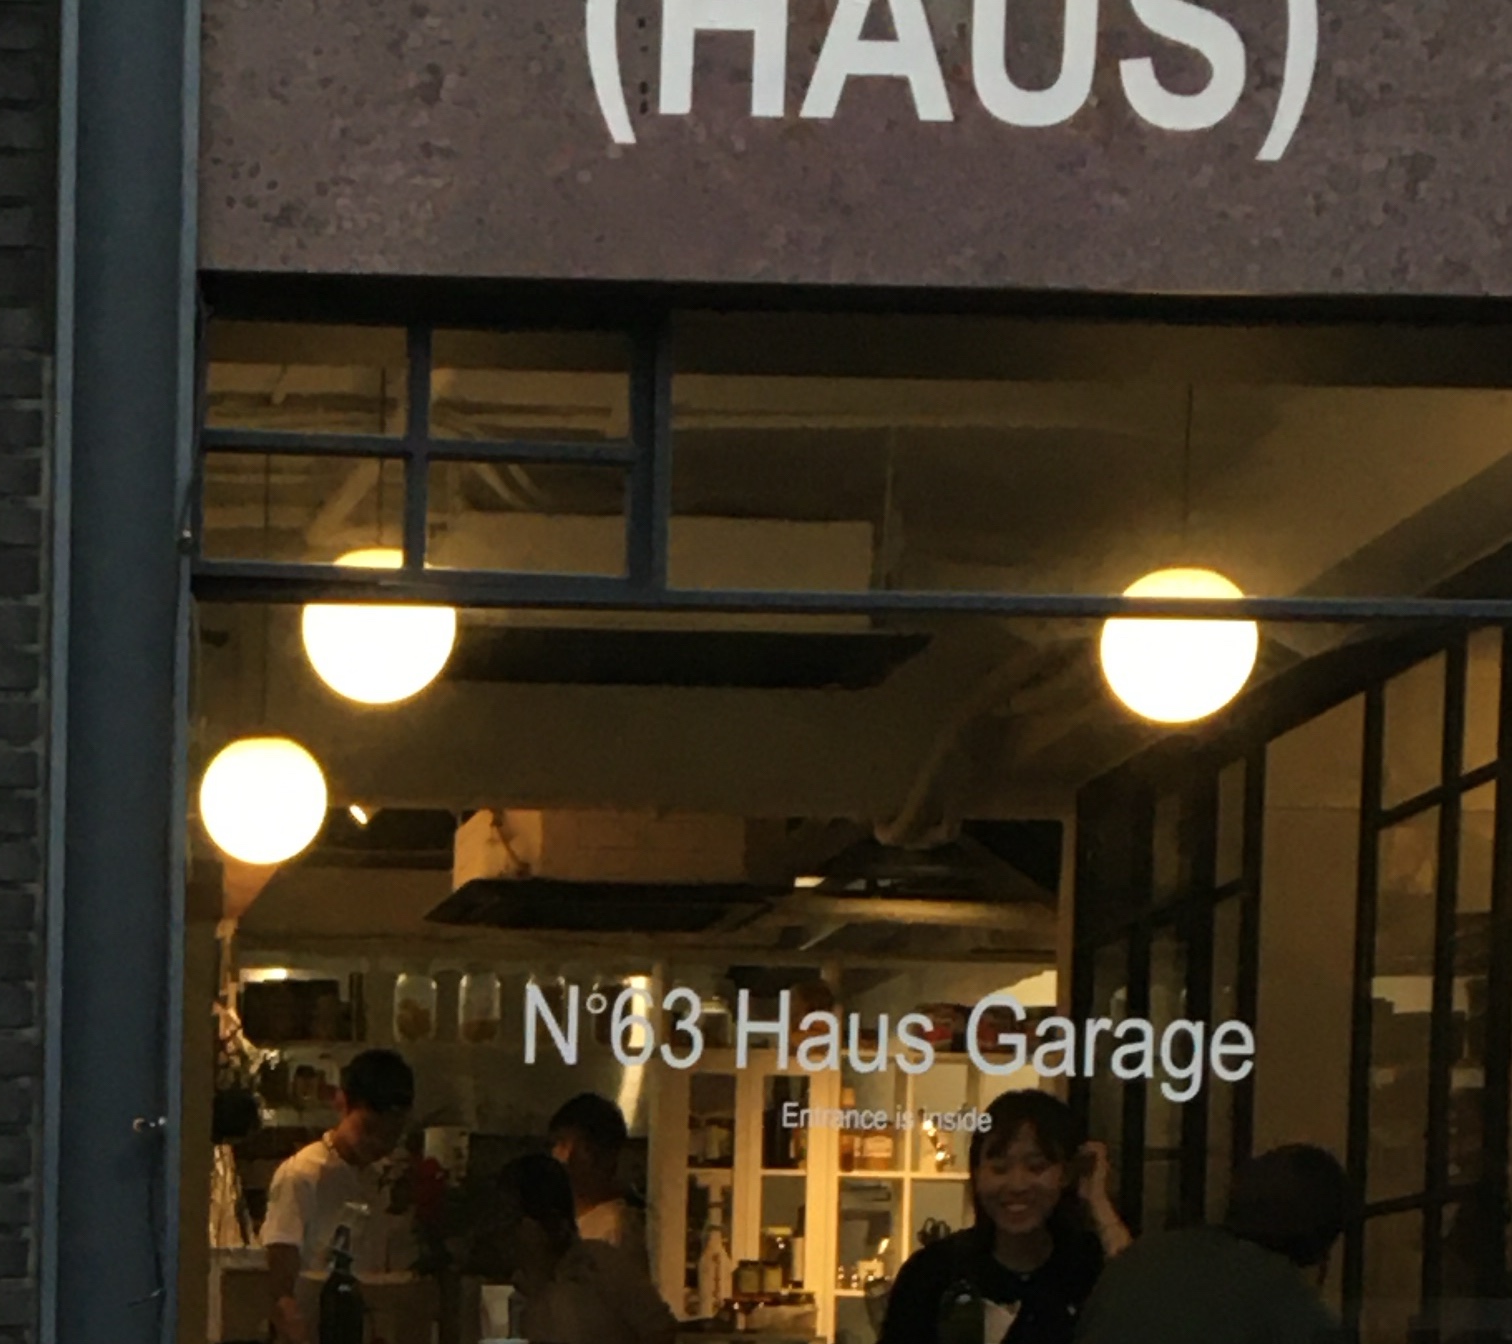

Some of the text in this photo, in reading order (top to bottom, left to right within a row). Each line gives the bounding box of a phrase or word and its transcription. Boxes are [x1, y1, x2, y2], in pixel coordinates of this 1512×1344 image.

[736, 988, 936, 1075] Haus
[965, 993, 1256, 1102] Garage
[781, 1101, 993, 1134] Entrance is inside
